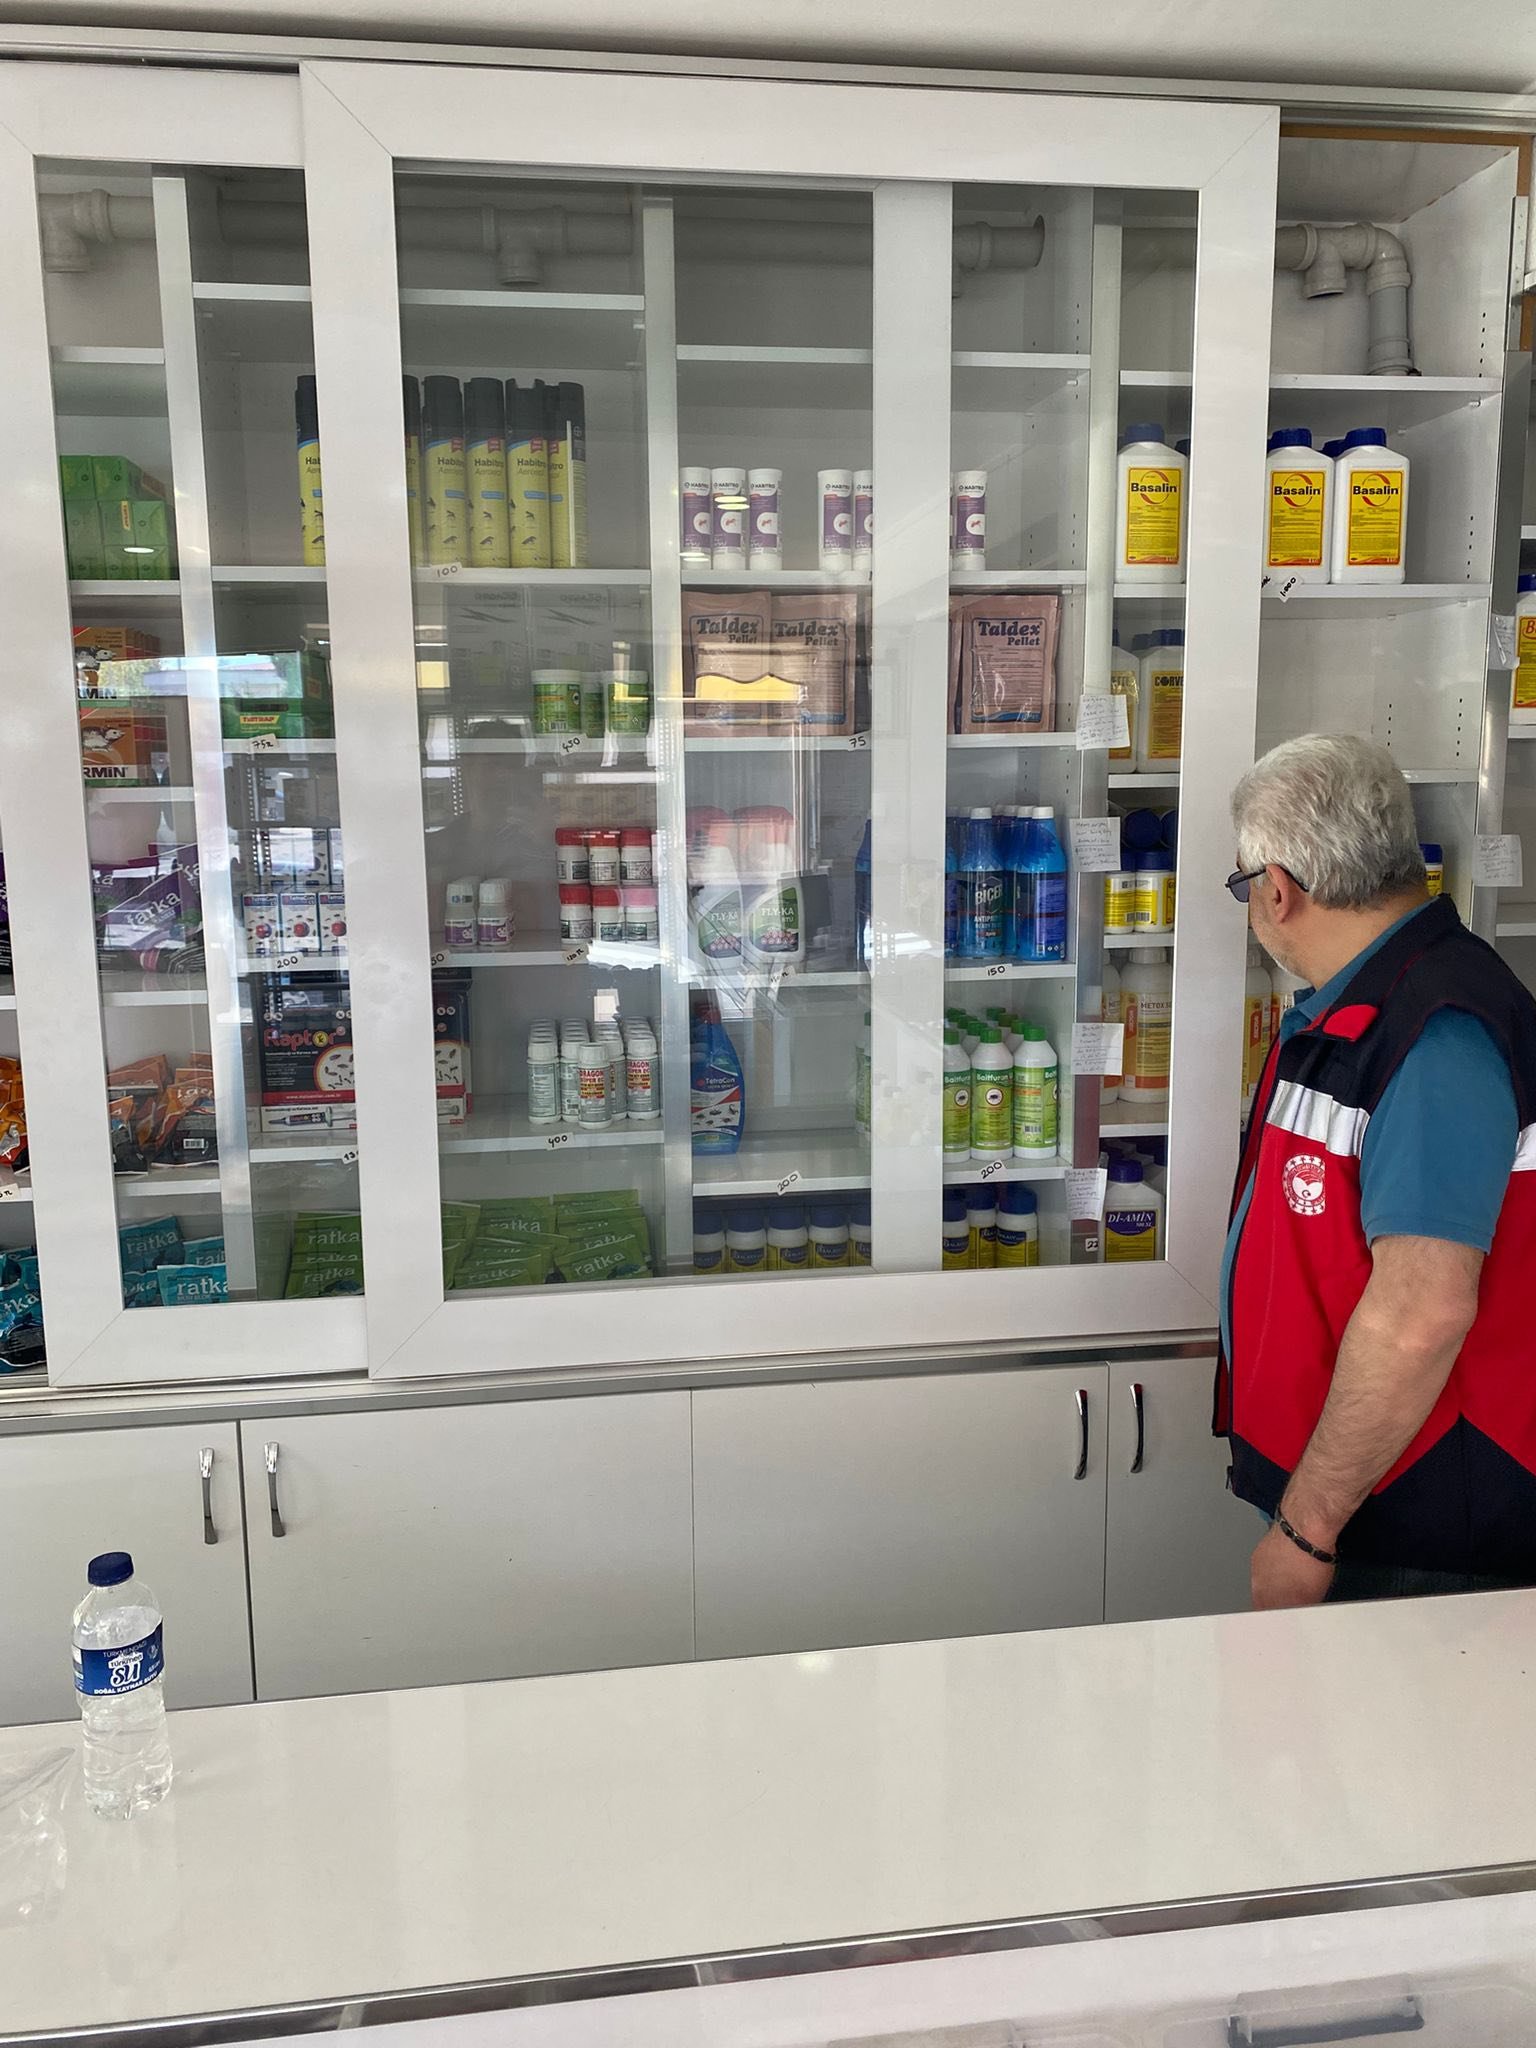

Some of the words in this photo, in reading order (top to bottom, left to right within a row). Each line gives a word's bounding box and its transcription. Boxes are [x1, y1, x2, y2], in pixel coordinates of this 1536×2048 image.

[1131, 483, 1177, 492] Basalin
[1274, 485, 1321, 495] Basalin
[1353, 485, 1399, 495] Basalin
[436, 564, 459, 578] 100
[696, 616, 759, 635] Taldex
[774, 621, 839, 637] Taldex
[978, 620, 1041, 637] Taldex
[804, 636, 839, 646] Pellet
[1007, 636, 1041, 646] Pellet
[849, 736, 866, 748] 75
[761, 907, 795, 917] FLY-KA
[277, 955, 298, 969] 200
[987, 965, 1006, 976] 150
[981, 1161, 1002, 1179] 200
[777, 1173, 798, 1191] 200
[126, 1230, 178, 1254] ratka
[309, 1230, 360, 1245] ratka
[574, 1252, 625, 1276] ratka
[177, 1278, 229, 1296] ratka
